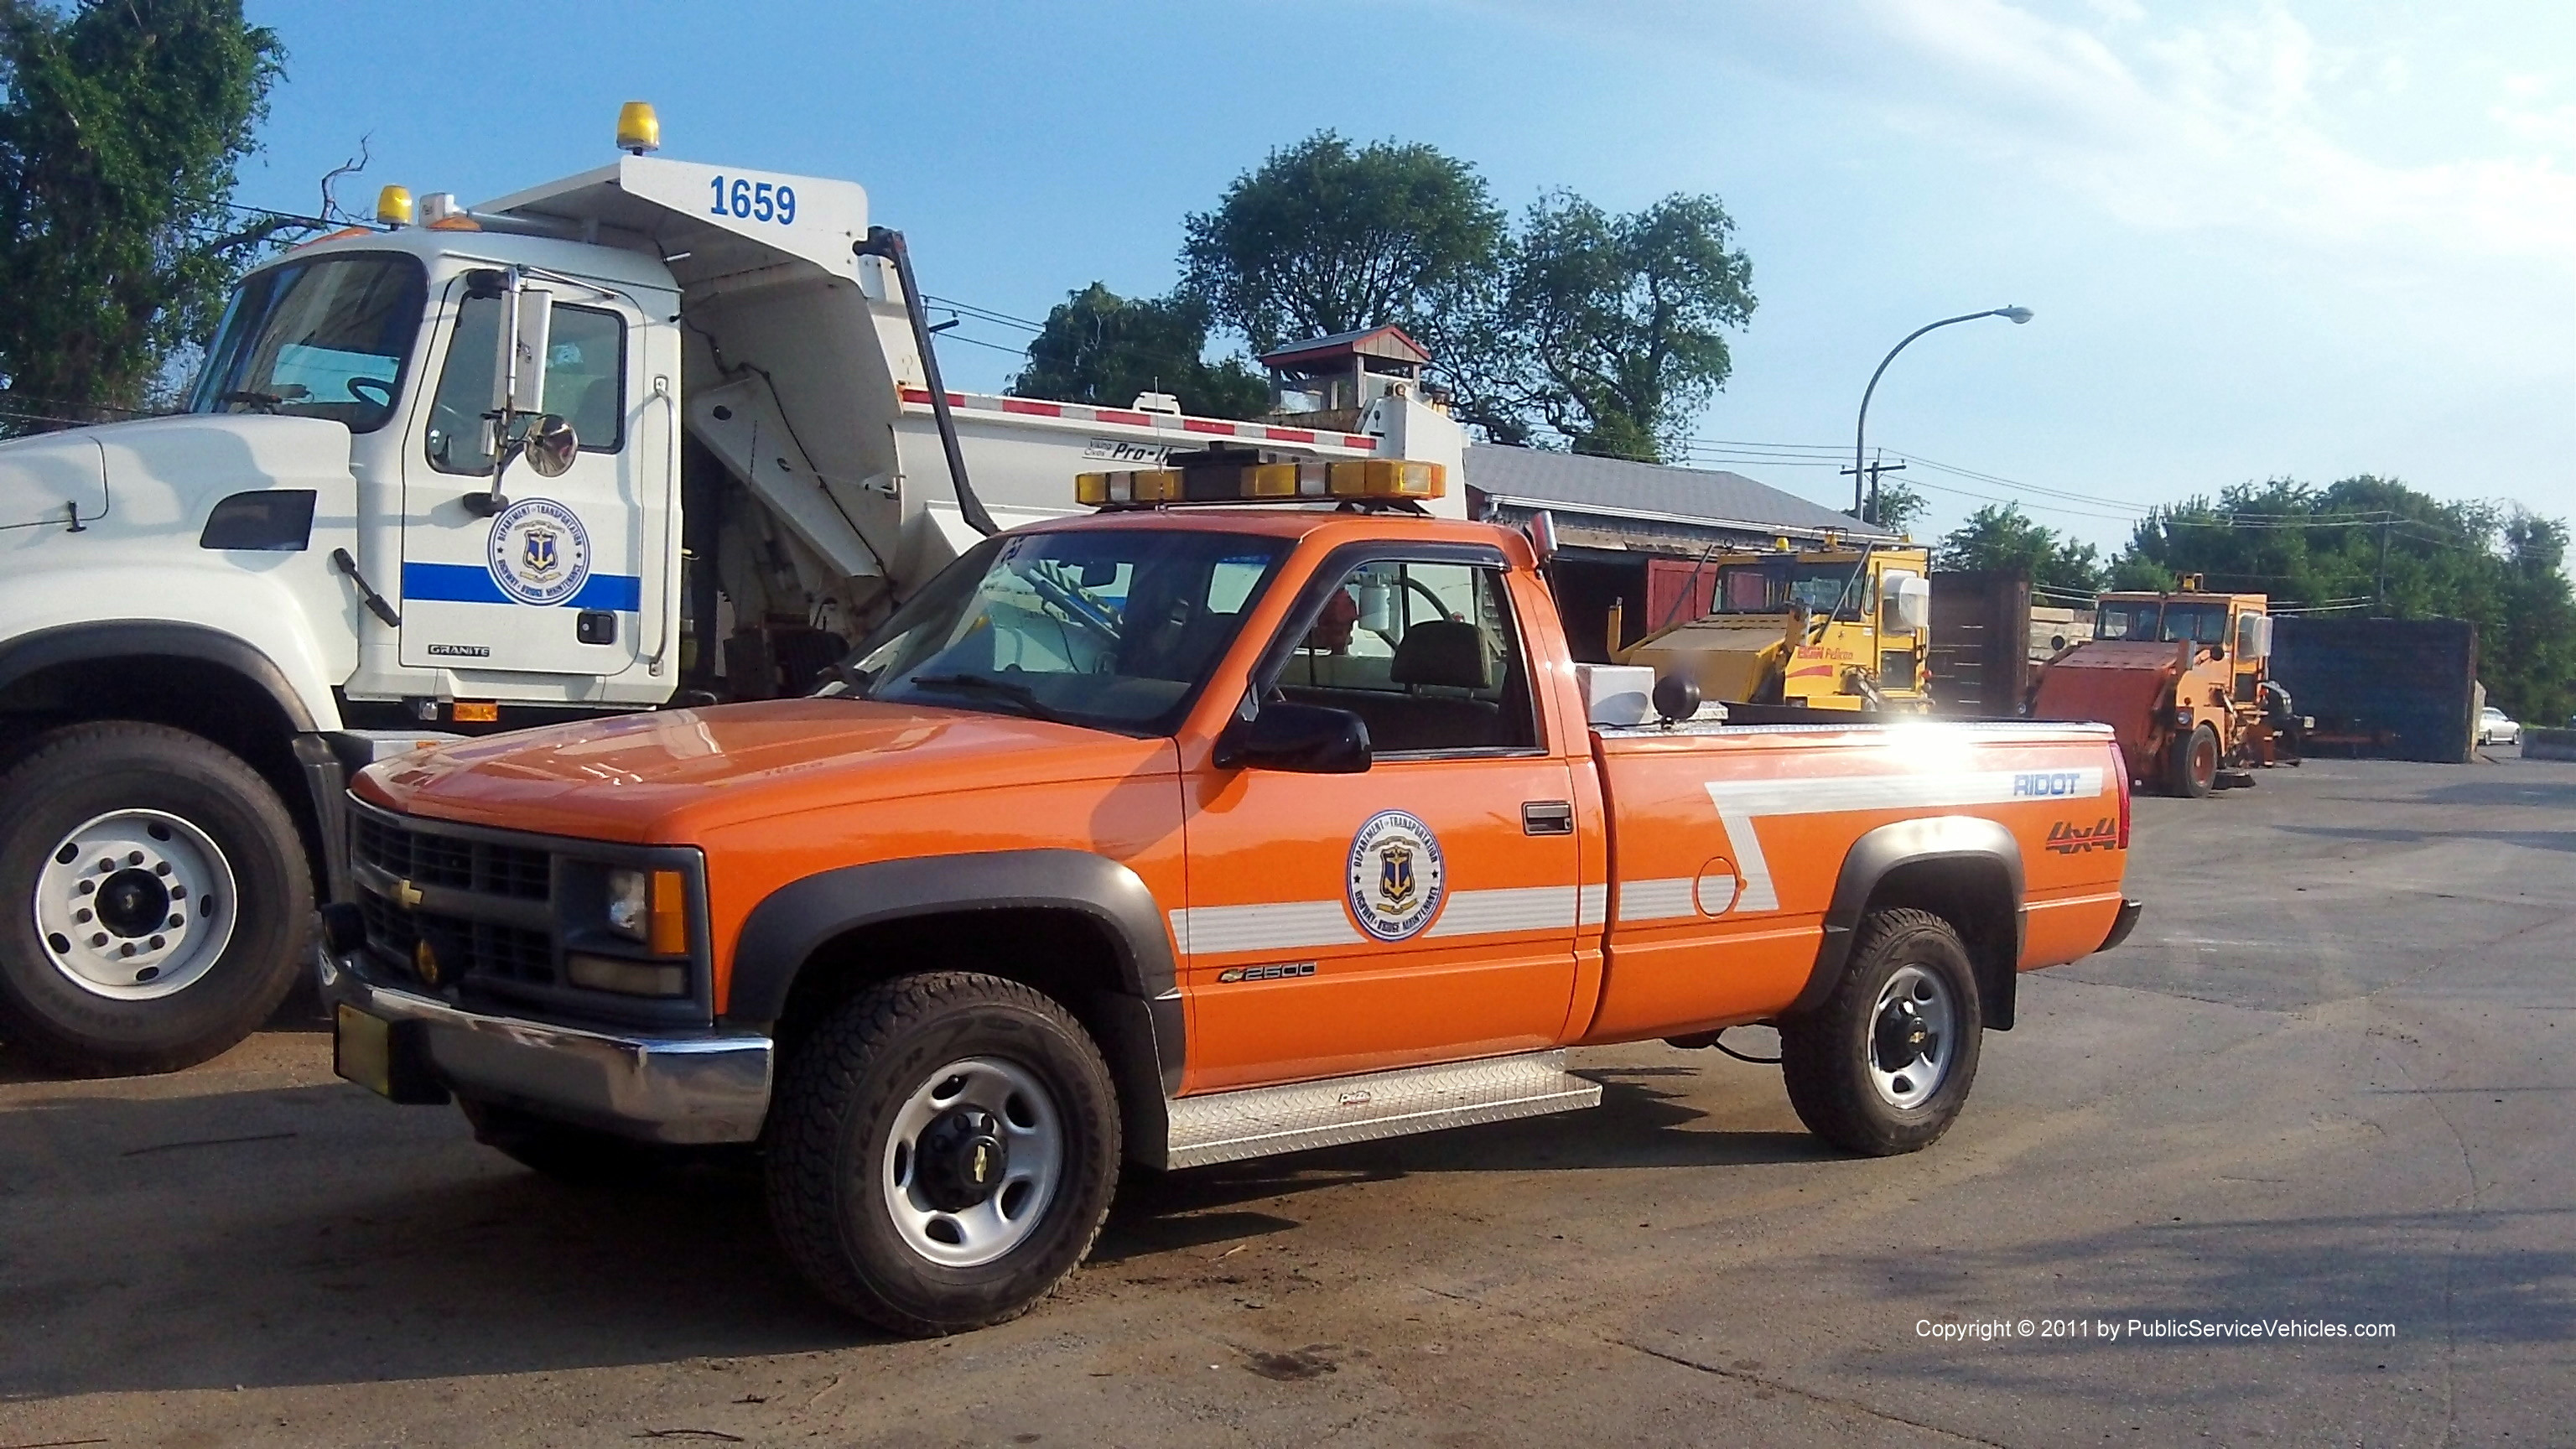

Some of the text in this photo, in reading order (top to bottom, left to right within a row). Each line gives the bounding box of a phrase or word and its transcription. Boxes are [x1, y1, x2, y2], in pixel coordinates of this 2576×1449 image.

[710, 174, 796, 225] 1659
[429, 645, 490, 656] GRANITE
[2014, 773, 2080, 796] RIDOT
[1353, 819, 1386, 867] DEPARTMENT
[1389, 816, 1439, 864] TRANSPORTATION
[1244, 962, 1317, 981] 2500
